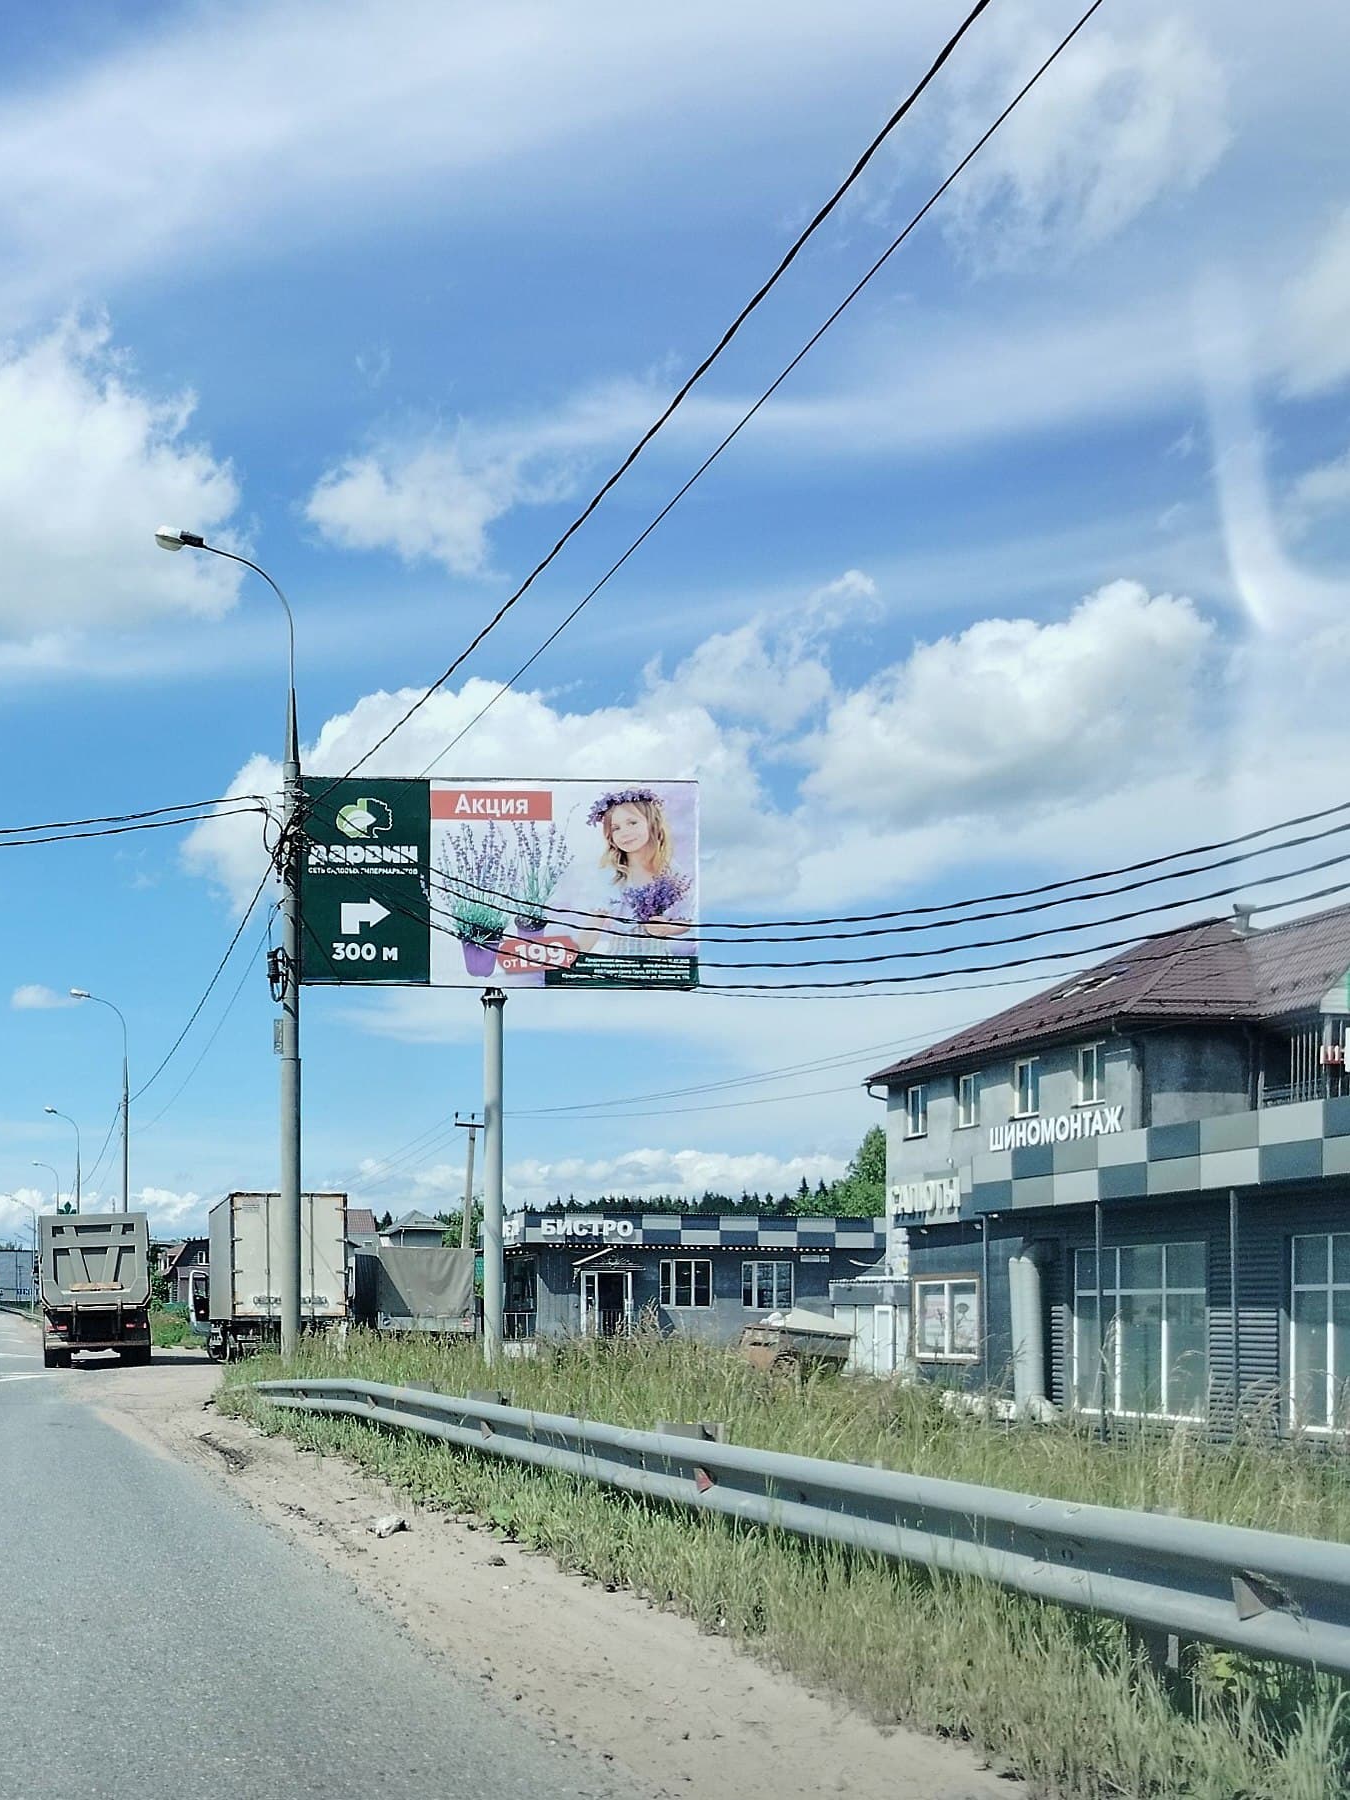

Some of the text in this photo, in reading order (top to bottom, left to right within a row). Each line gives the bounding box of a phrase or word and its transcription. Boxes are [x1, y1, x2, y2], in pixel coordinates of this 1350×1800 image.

[454, 793, 529, 817] Акция
[332, 942, 376, 961] 300
[515, 942, 567, 968] 199
[989, 1105, 1123, 1151] ШИНОМОНТАЖ
[541, 1218, 634, 1237] БИСТРО
